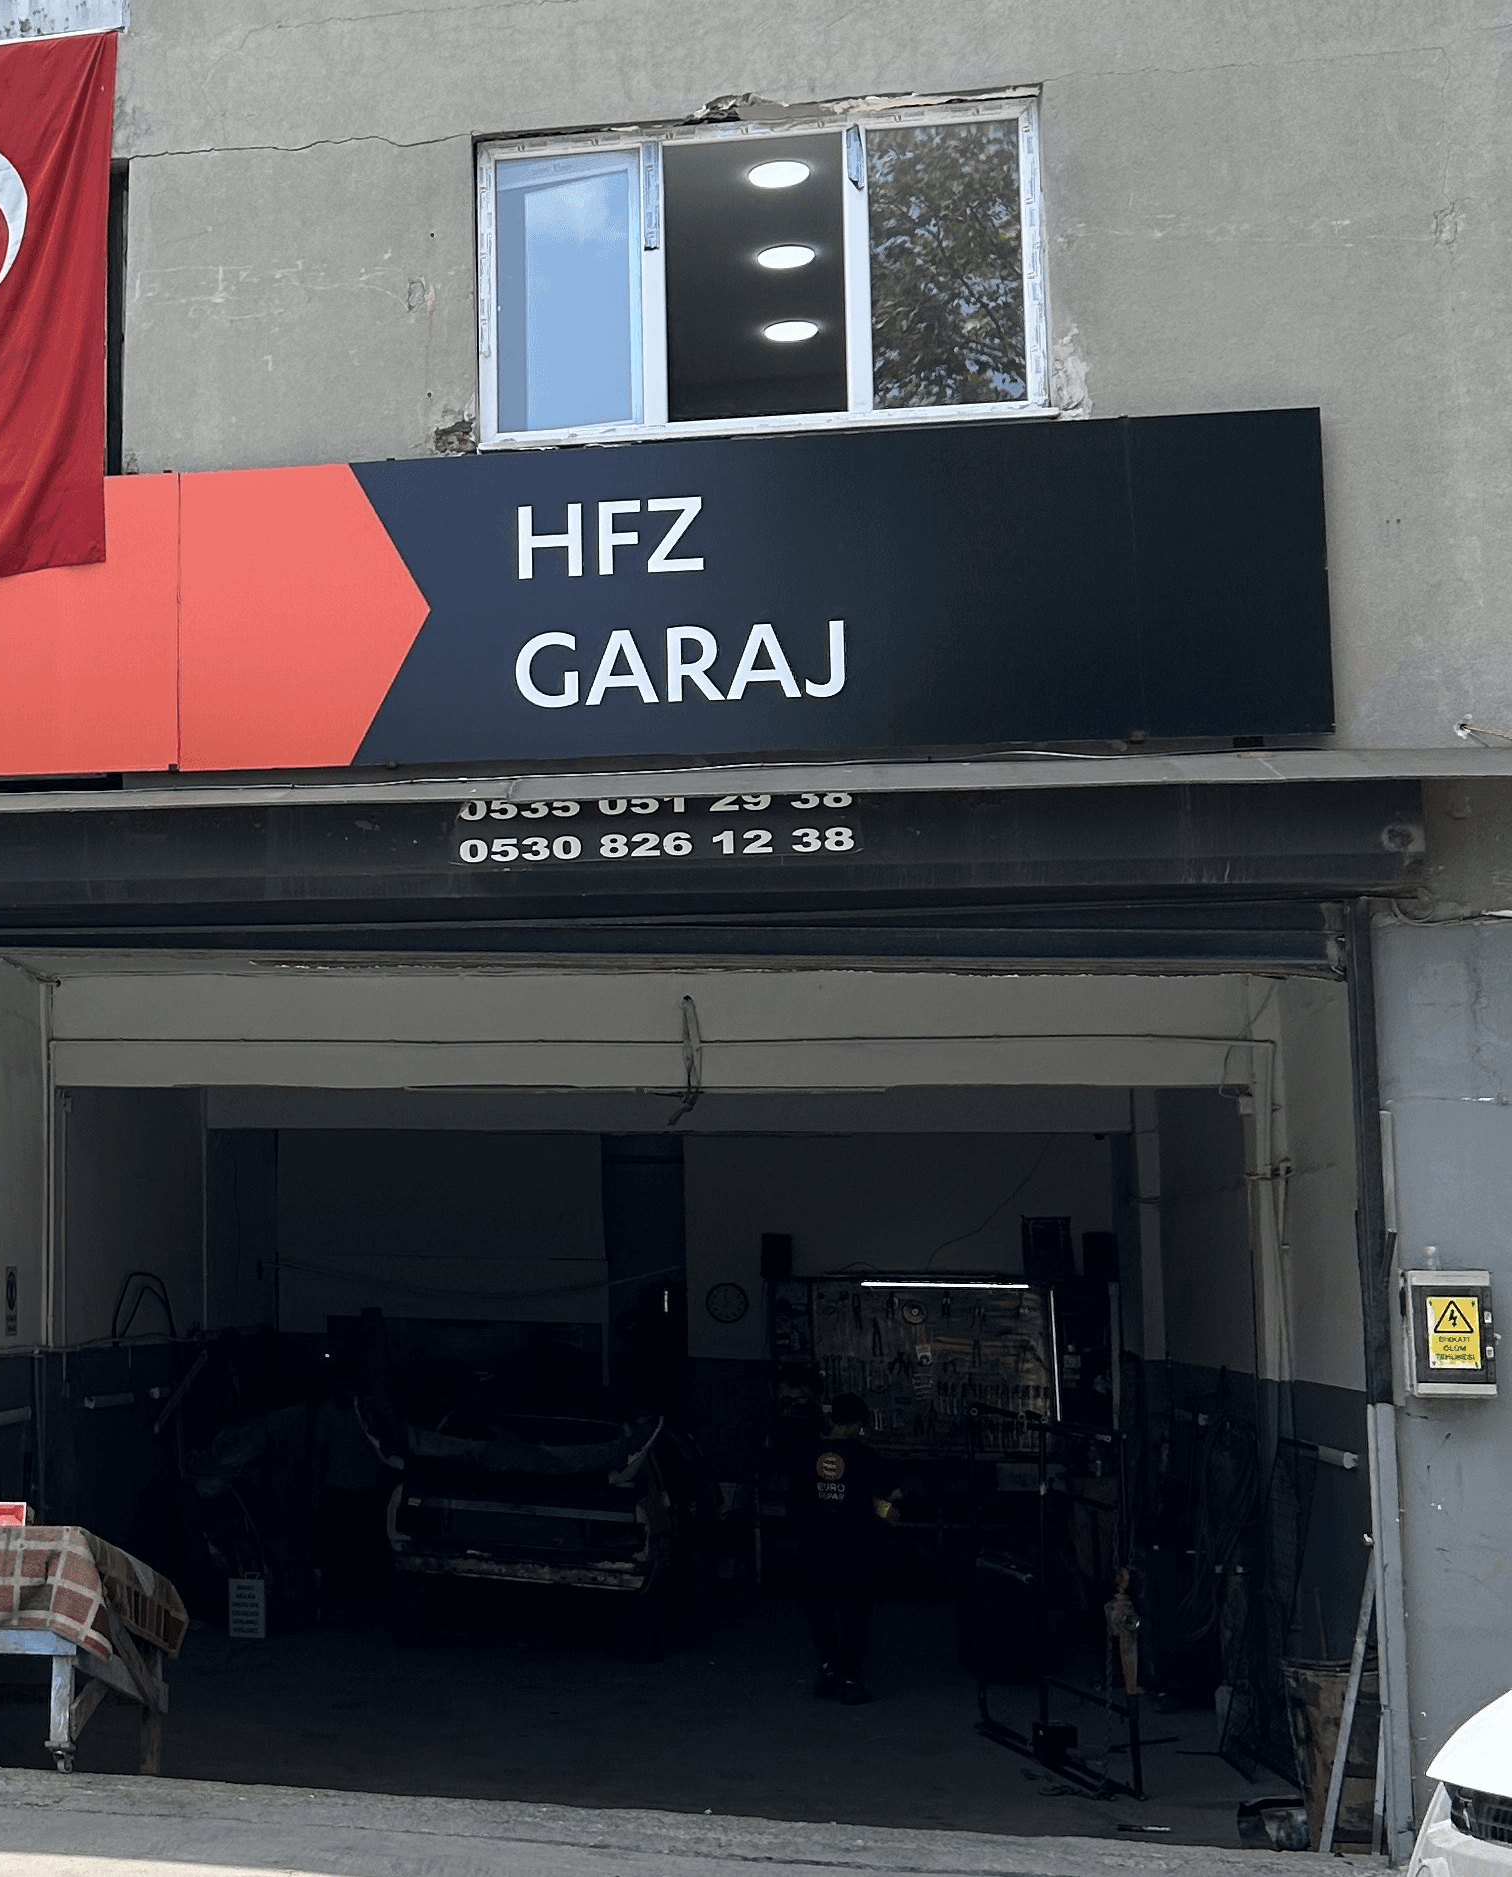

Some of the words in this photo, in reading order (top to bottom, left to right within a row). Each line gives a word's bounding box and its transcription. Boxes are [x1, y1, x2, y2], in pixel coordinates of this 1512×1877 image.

[517, 496, 705, 580] HFZ
[515, 620, 846, 708] GARAJ
[459, 835, 582, 863] 0530
[599, 831, 693, 858] 826
[712, 829, 773, 855] 12
[791, 826, 855, 853] 38
